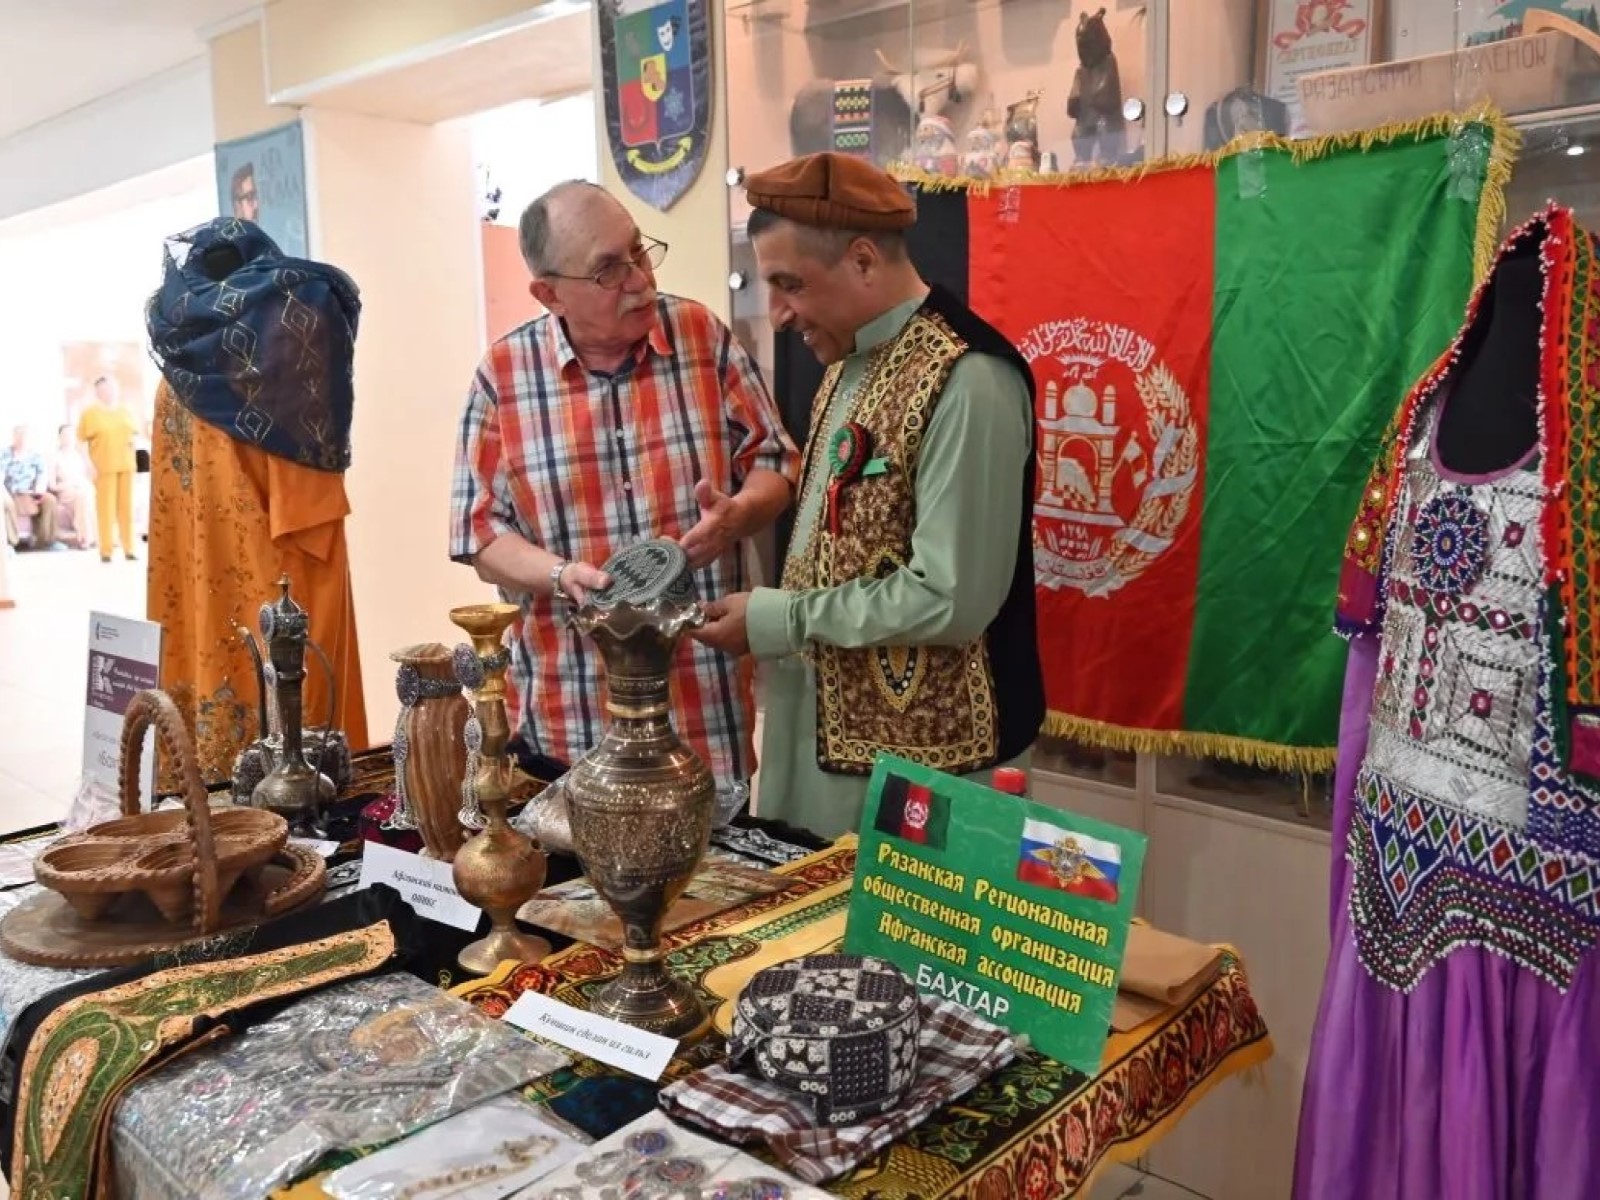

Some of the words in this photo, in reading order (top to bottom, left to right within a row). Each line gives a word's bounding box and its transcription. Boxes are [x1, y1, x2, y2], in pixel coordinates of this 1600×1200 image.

[432, 882, 457, 896] камен
[863, 875, 981, 936] общественная
[991, 925, 1115, 988] организация
[878, 843, 965, 893] Рязанская
[974, 878, 1109, 947] Региональная
[878, 911, 967, 965] Афганская
[977, 955, 1082, 1014] ассоциация
[916, 963, 1010, 1018] БАХТАР
